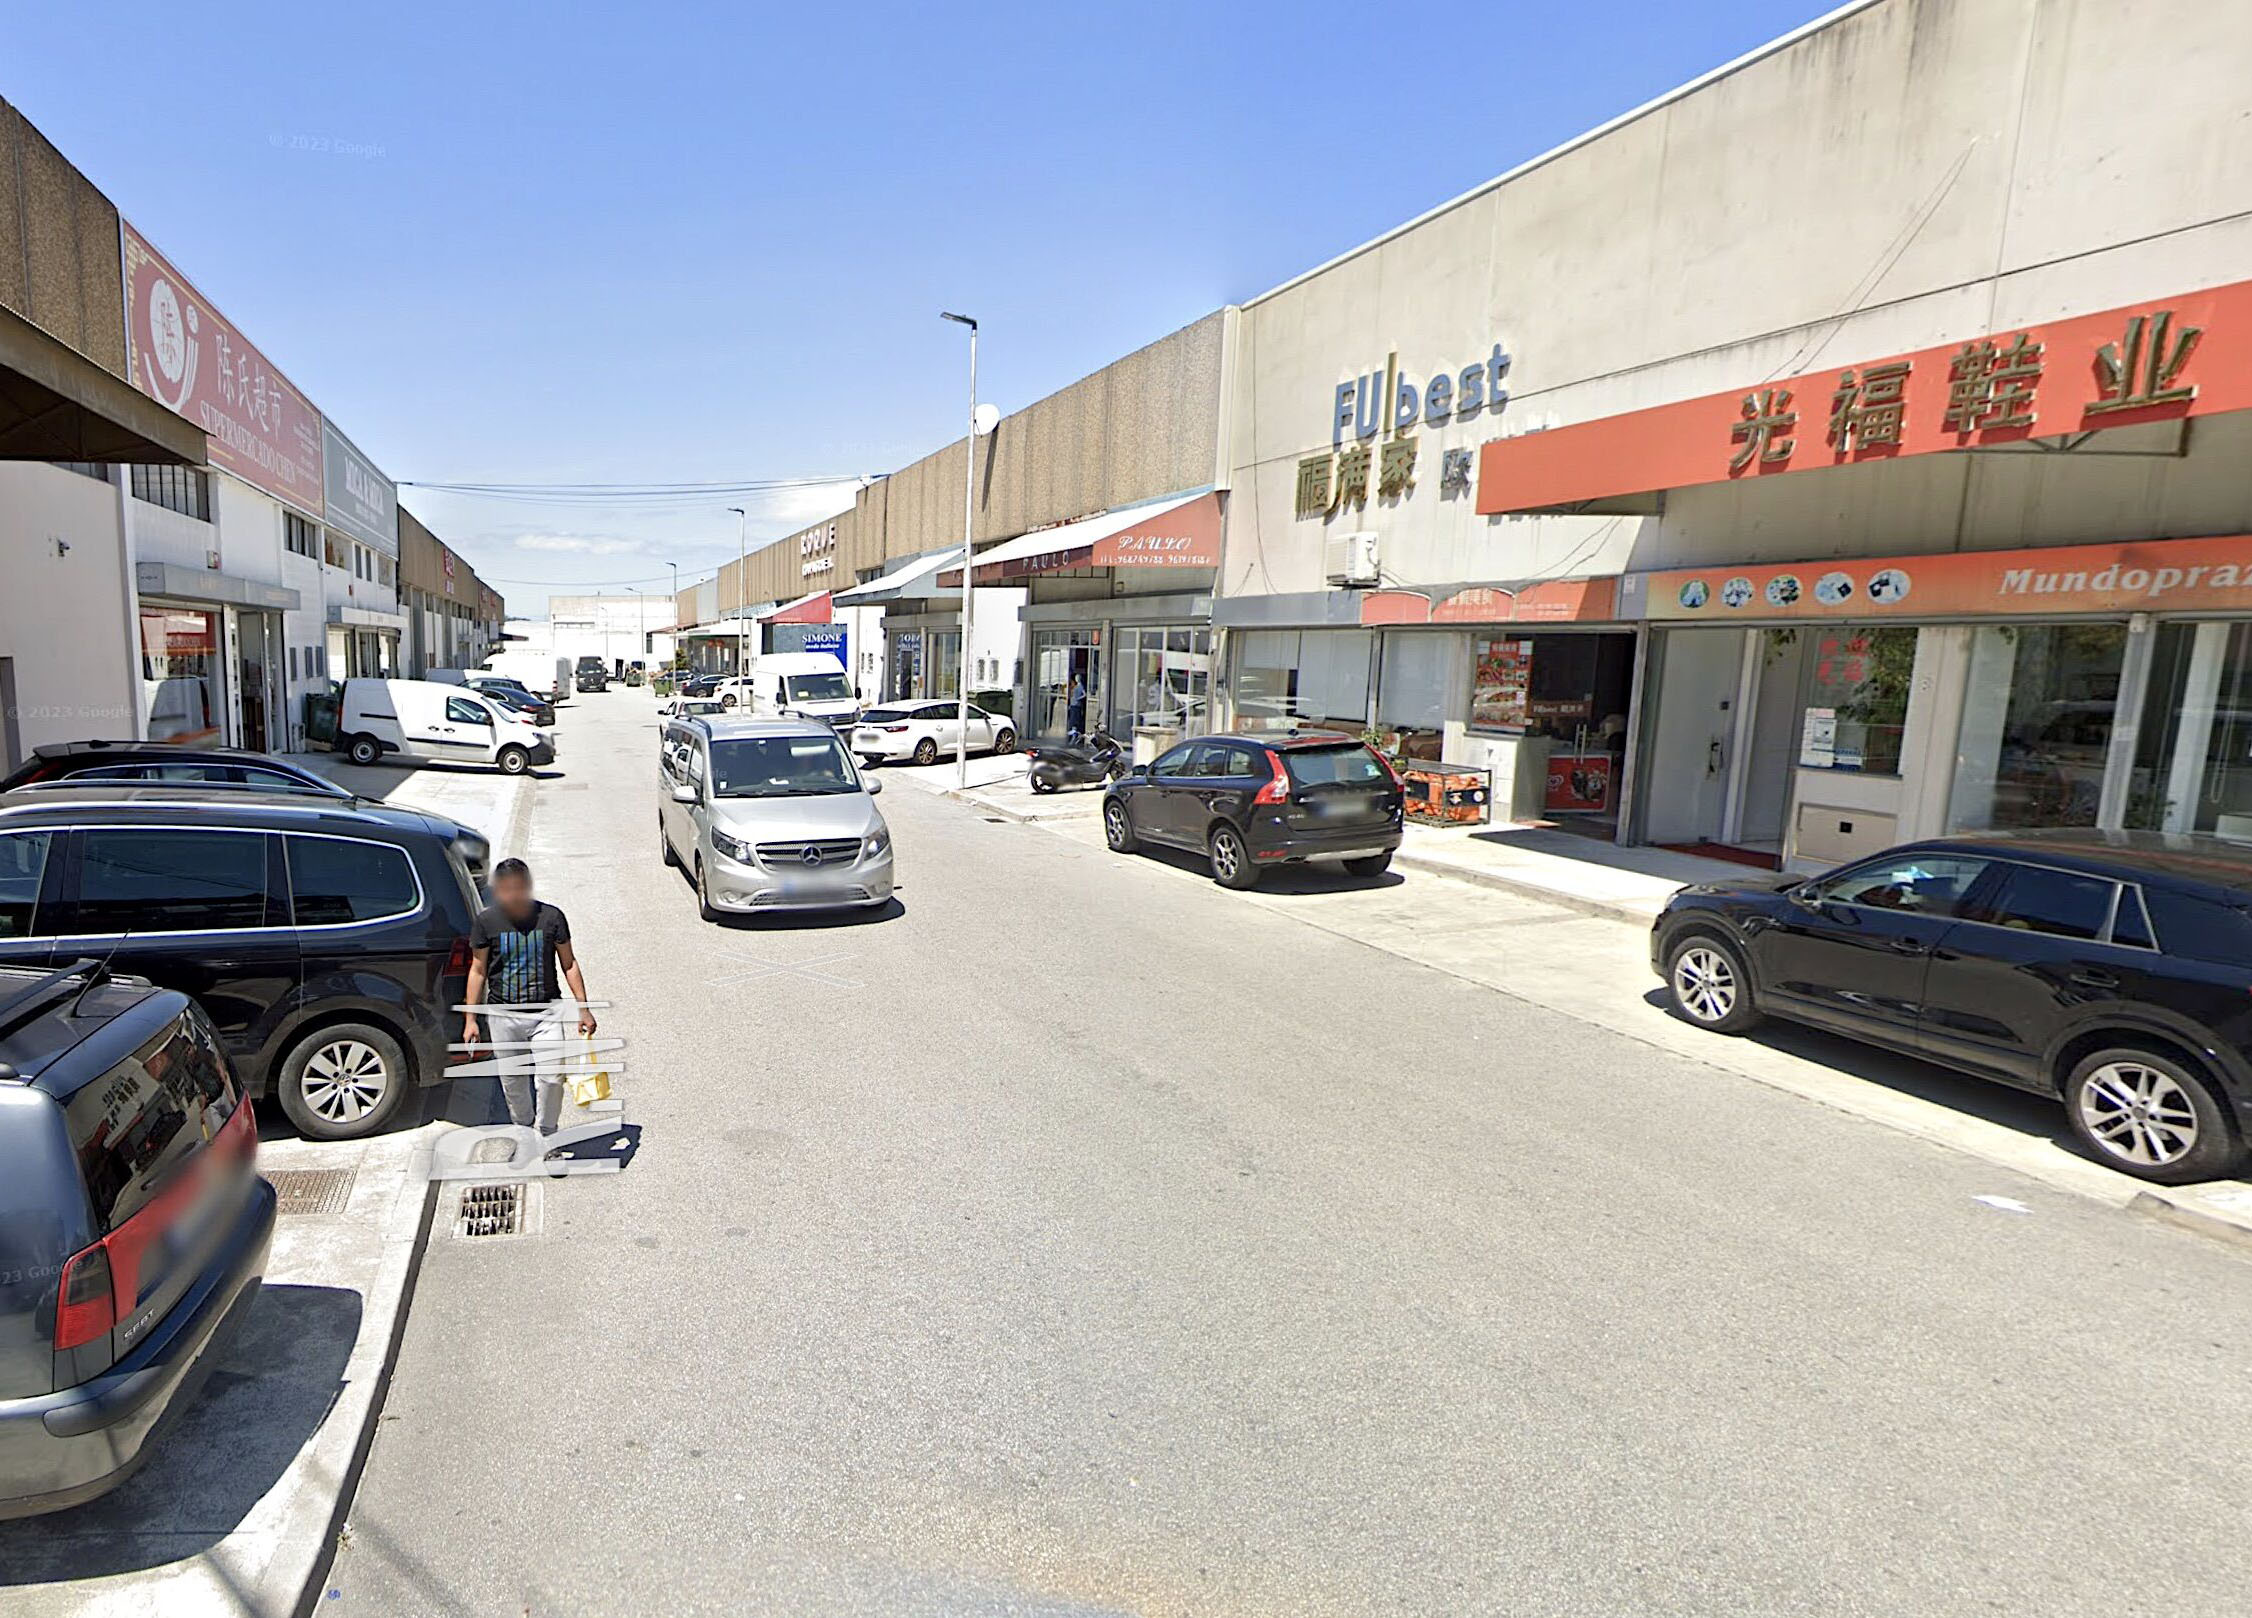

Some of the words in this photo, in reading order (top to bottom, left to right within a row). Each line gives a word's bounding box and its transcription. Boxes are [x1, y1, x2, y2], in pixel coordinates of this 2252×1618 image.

[1730, 310, 2201, 468] 光福鞋业
[1022, 551, 1070, 572] PAULO
[801, 633, 842, 643] SIMONE
